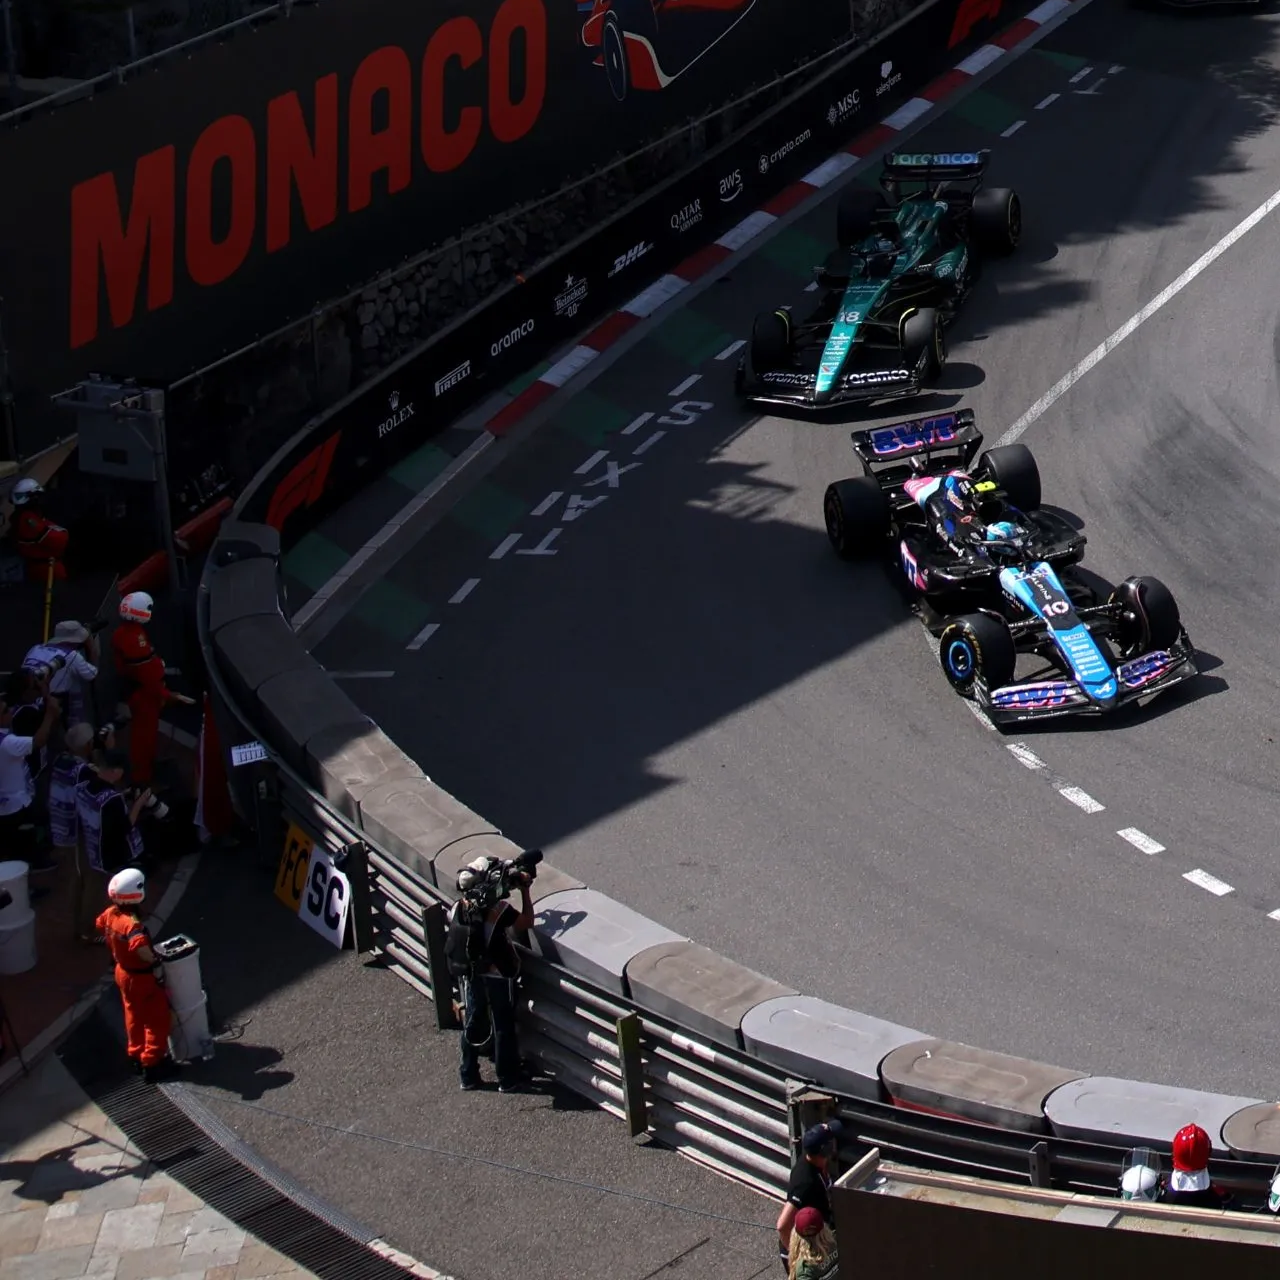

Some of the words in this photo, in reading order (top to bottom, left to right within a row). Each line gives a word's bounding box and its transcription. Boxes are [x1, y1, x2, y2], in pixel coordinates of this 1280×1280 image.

[377, 402, 417, 440] ROLEX
[434, 359, 471, 398] PIRELLI
[490, 318, 536, 357] aramco
[669, 198, 702, 231] QATAR
[769, 127, 813, 165] crypto.com
[836, 88, 862, 116] MSC
[848, 368, 910, 385] aramco
[1041, 600, 1070, 618] 10
[307, 861, 345, 931] SC
